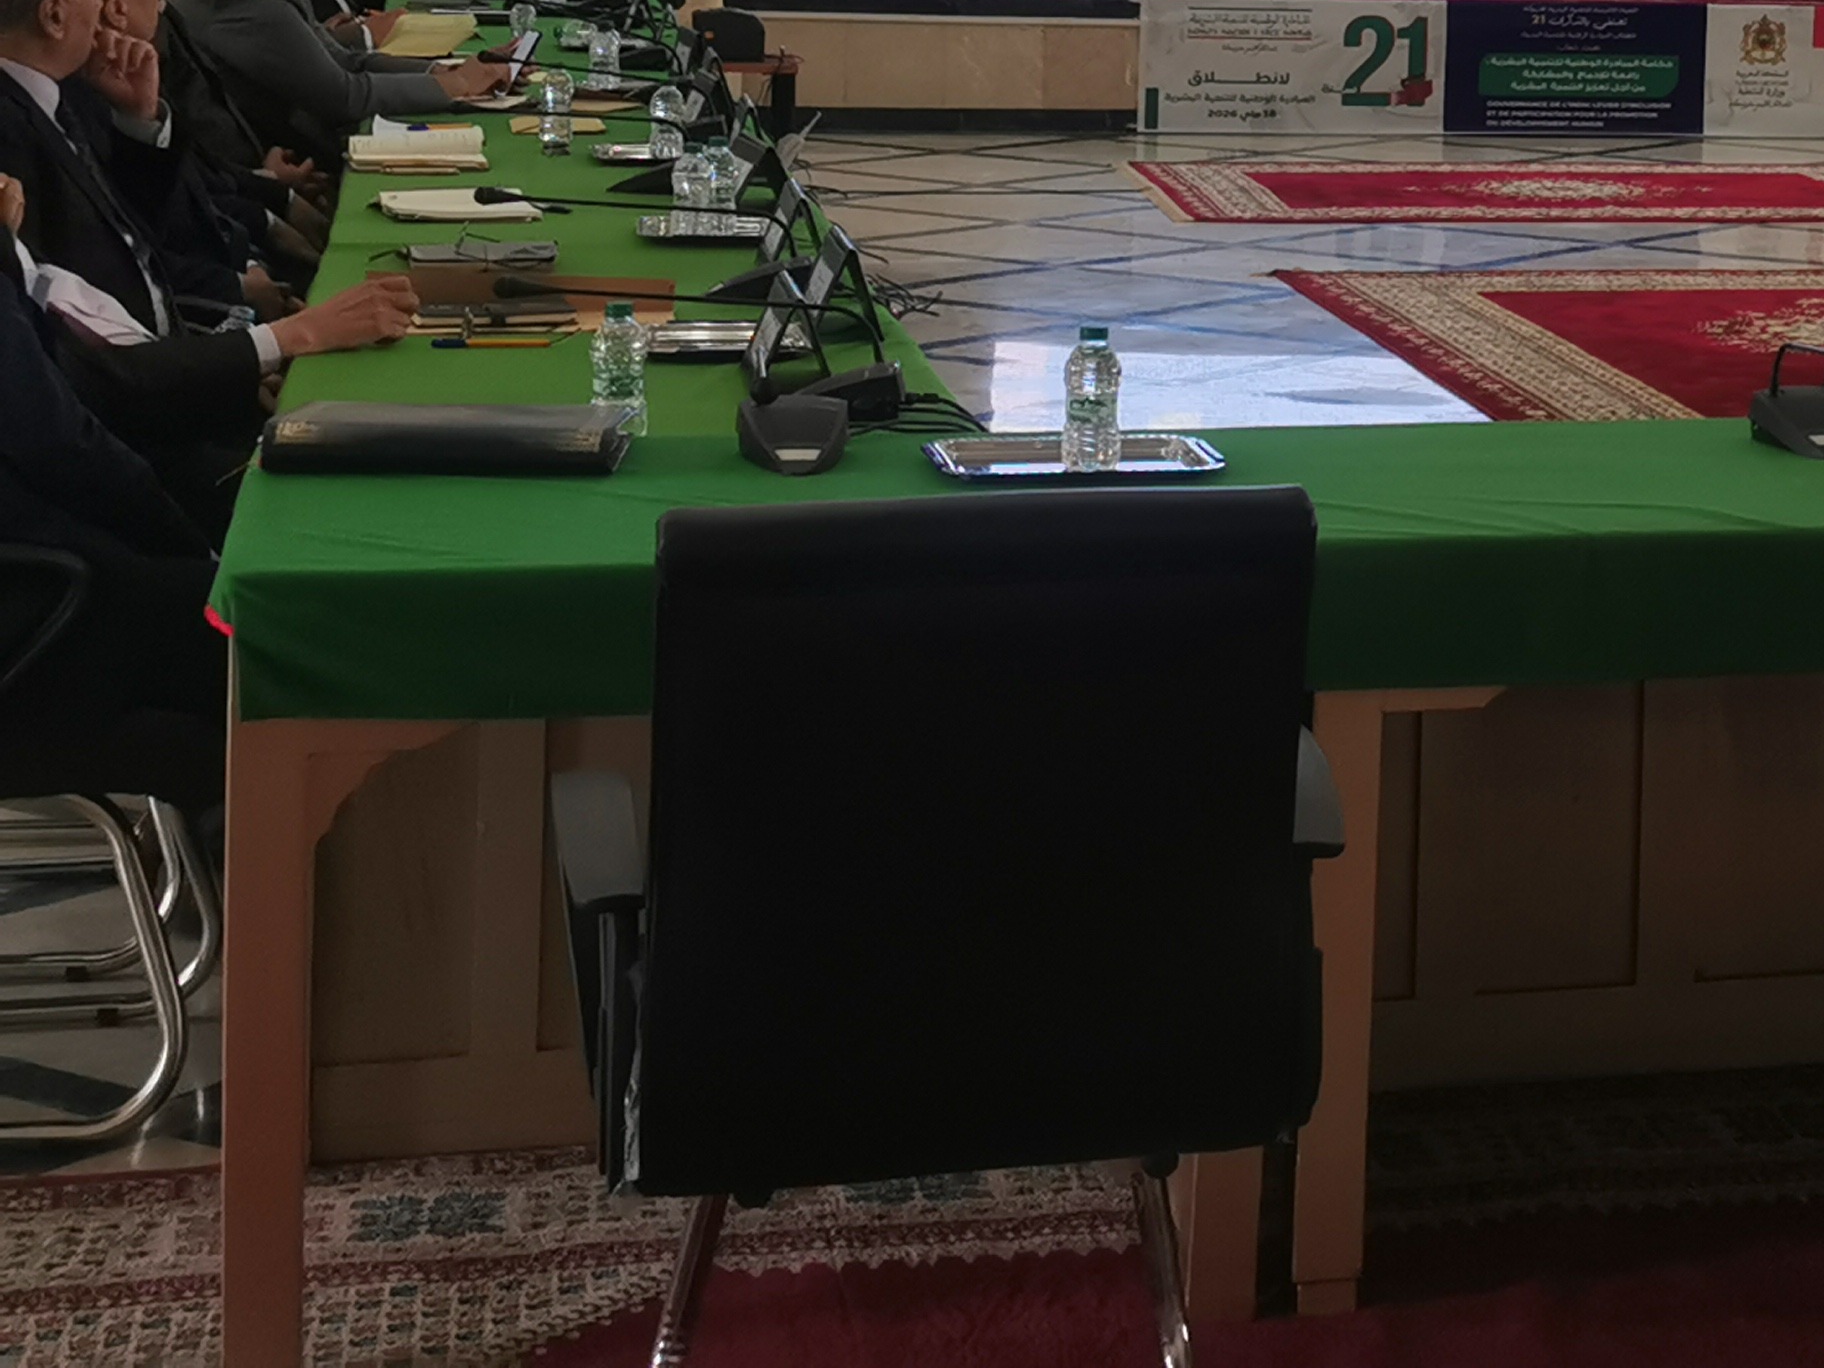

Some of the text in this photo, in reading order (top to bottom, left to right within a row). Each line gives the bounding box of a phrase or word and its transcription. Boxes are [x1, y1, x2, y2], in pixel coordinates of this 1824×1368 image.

[1531, 13, 1547, 25] 21
[1342, 14, 1431, 107] 21
[1187, 69, 1291, 86] لانطلاق
